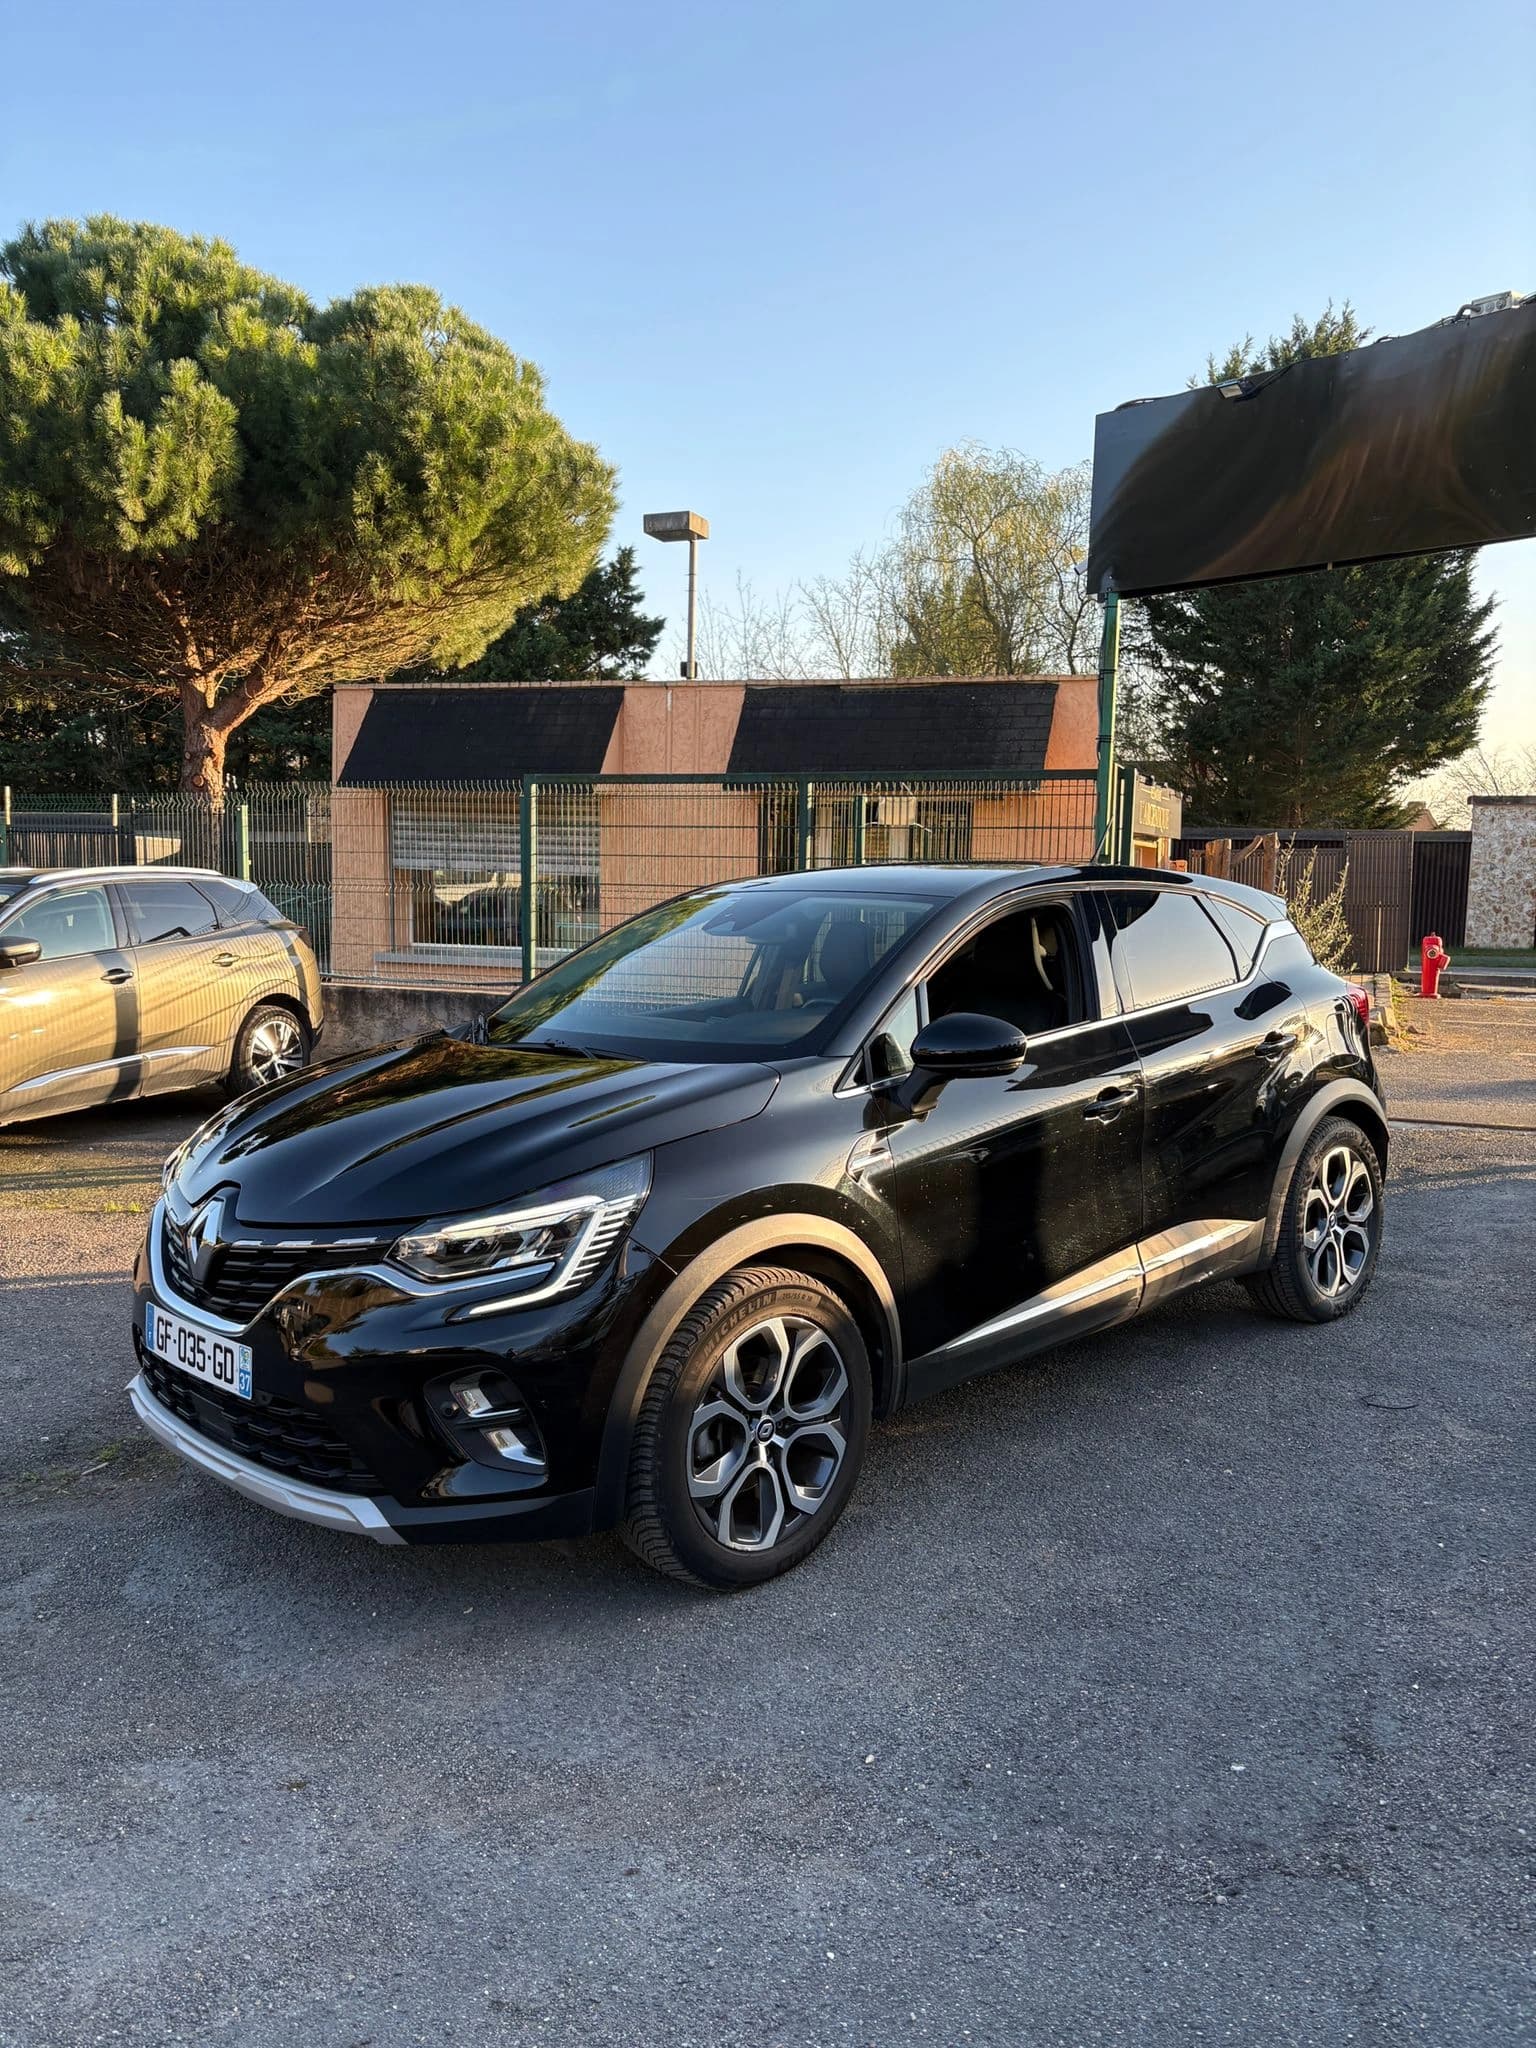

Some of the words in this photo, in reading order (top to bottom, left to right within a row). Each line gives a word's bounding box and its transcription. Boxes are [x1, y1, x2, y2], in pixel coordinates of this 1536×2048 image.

[156, 1315, 235, 1385] GF-035-GD
[703, 1293, 773, 1357] MICHELIN
[240, 1371, 251, 1392] 37
